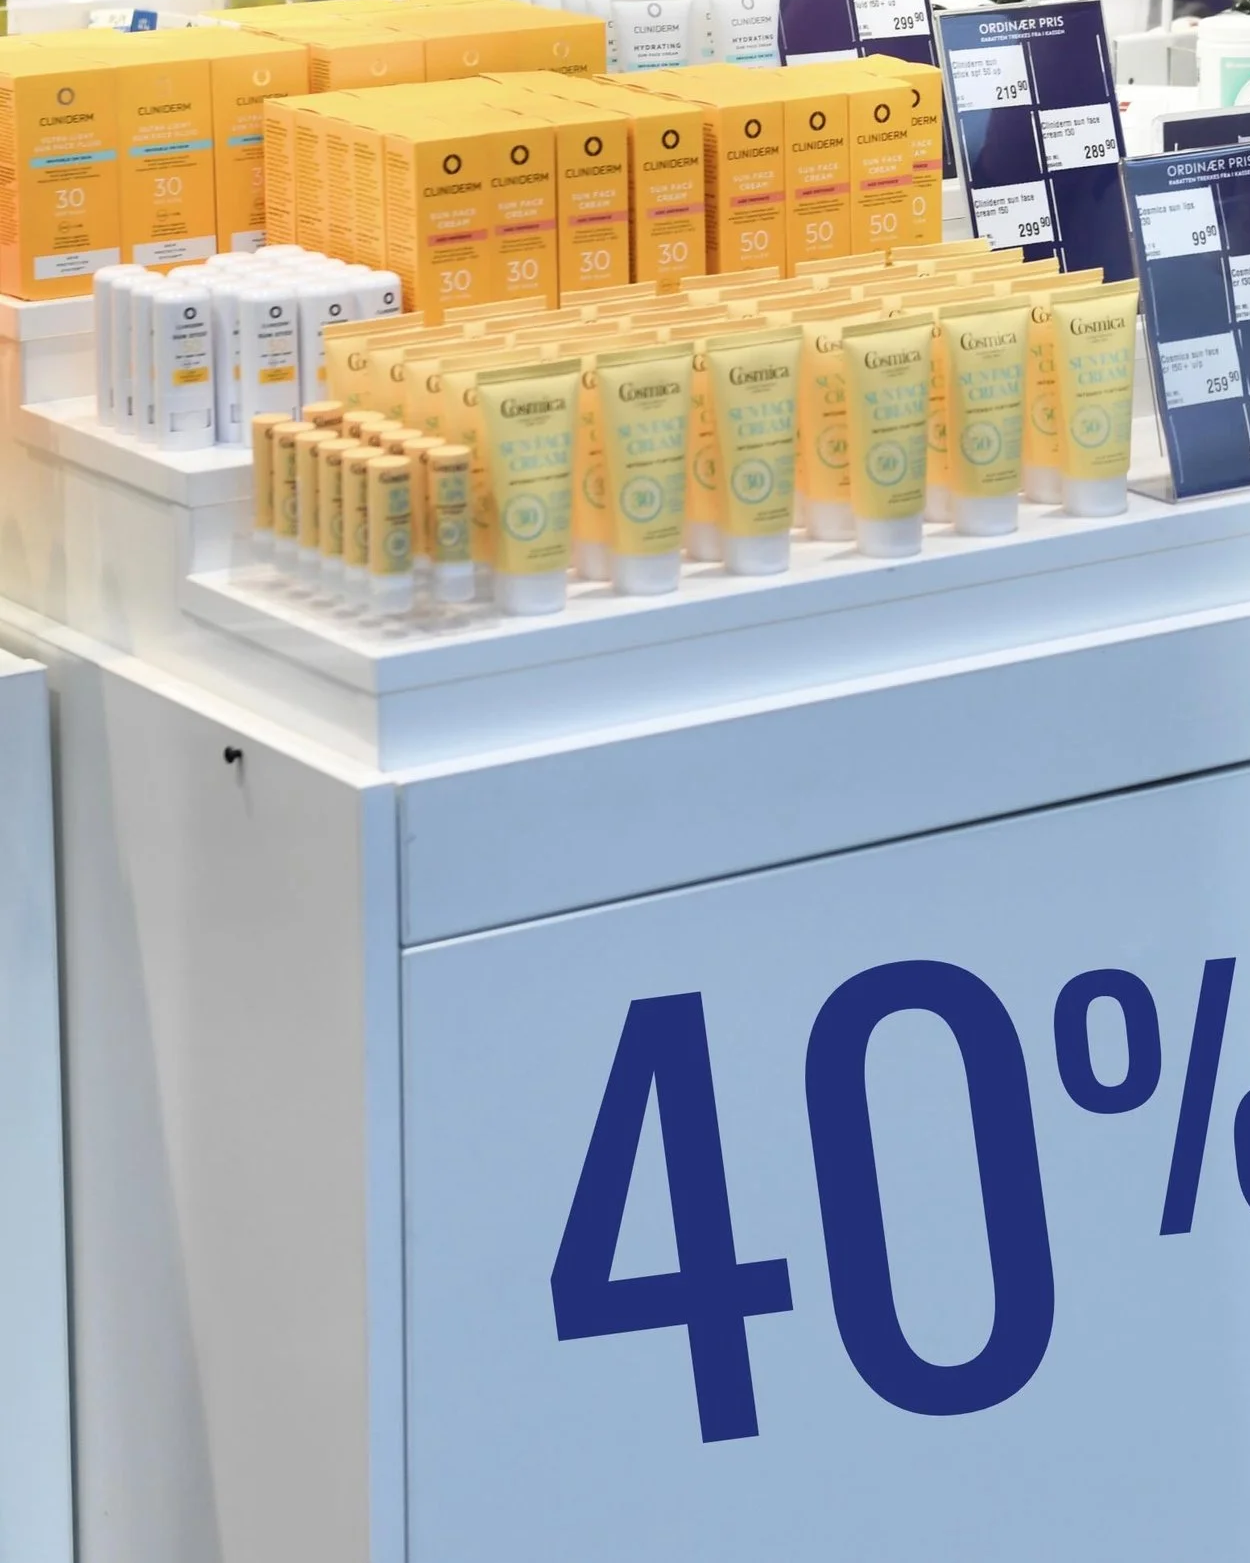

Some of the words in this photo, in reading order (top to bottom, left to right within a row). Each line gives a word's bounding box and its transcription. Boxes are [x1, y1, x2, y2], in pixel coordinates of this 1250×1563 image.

[634, 24, 679, 34] CLINIDERM
[731, 16, 772, 27] CLINIDERM
[894, 16, 914, 30] 299
[914, 11, 925, 22] 90
[979, 19, 1036, 34] ORDINÆR
[1039, 16, 1064, 28] PRIS
[634, 42, 681, 51] HYDRATING
[732, 34, 774, 44] HYDRATING
[996, 85, 1017, 100] 219
[1017, 80, 1028, 91] 90
[138, 103, 192, 116] CLINIDERM
[39, 113, 94, 127] CLINIDERM
[1041, 120, 1072, 130] Cliniderm
[792, 137, 844, 153] CLINIDERM
[857, 130, 907, 145] CLINIDERM
[727, 146, 779, 161] CLINIDERM
[1084, 144, 1105, 159] 289
[1105, 139, 1116, 150] 90
[565, 164, 622, 179] CLINIDERM
[643, 157, 699, 172] CLINIDERM
[1167, 159, 1225, 177] ORDINÆR
[154, 177, 182, 198] 30
[491, 172, 549, 188] CLINIDERM
[55, 188, 85, 209] 30
[423, 182, 482, 198] CLINIDERM
[974, 197, 1006, 208] Cliniderm
[806, 221, 833, 244] 50
[870, 213, 897, 235] 50
[1019, 221, 1040, 238] 299
[1040, 216, 1051, 227] 90
[741, 230, 768, 252] 50
[1192, 231, 1207, 246] 99
[1206, 225, 1217, 237] 90
[580, 250, 611, 273] 30
[658, 241, 688, 265] 30
[507, 259, 538, 282] 30
[440, 269, 472, 293] 30
[1070, 315, 1126, 336] Cosmica
[960, 331, 1017, 351] Cosmica
[865, 350, 922, 369] Cosmica
[729, 365, 790, 386] Cosmica
[1207, 376, 1229, 394] 259
[1229, 370, 1240, 382] 90
[618, 381, 681, 403] Cosmica
